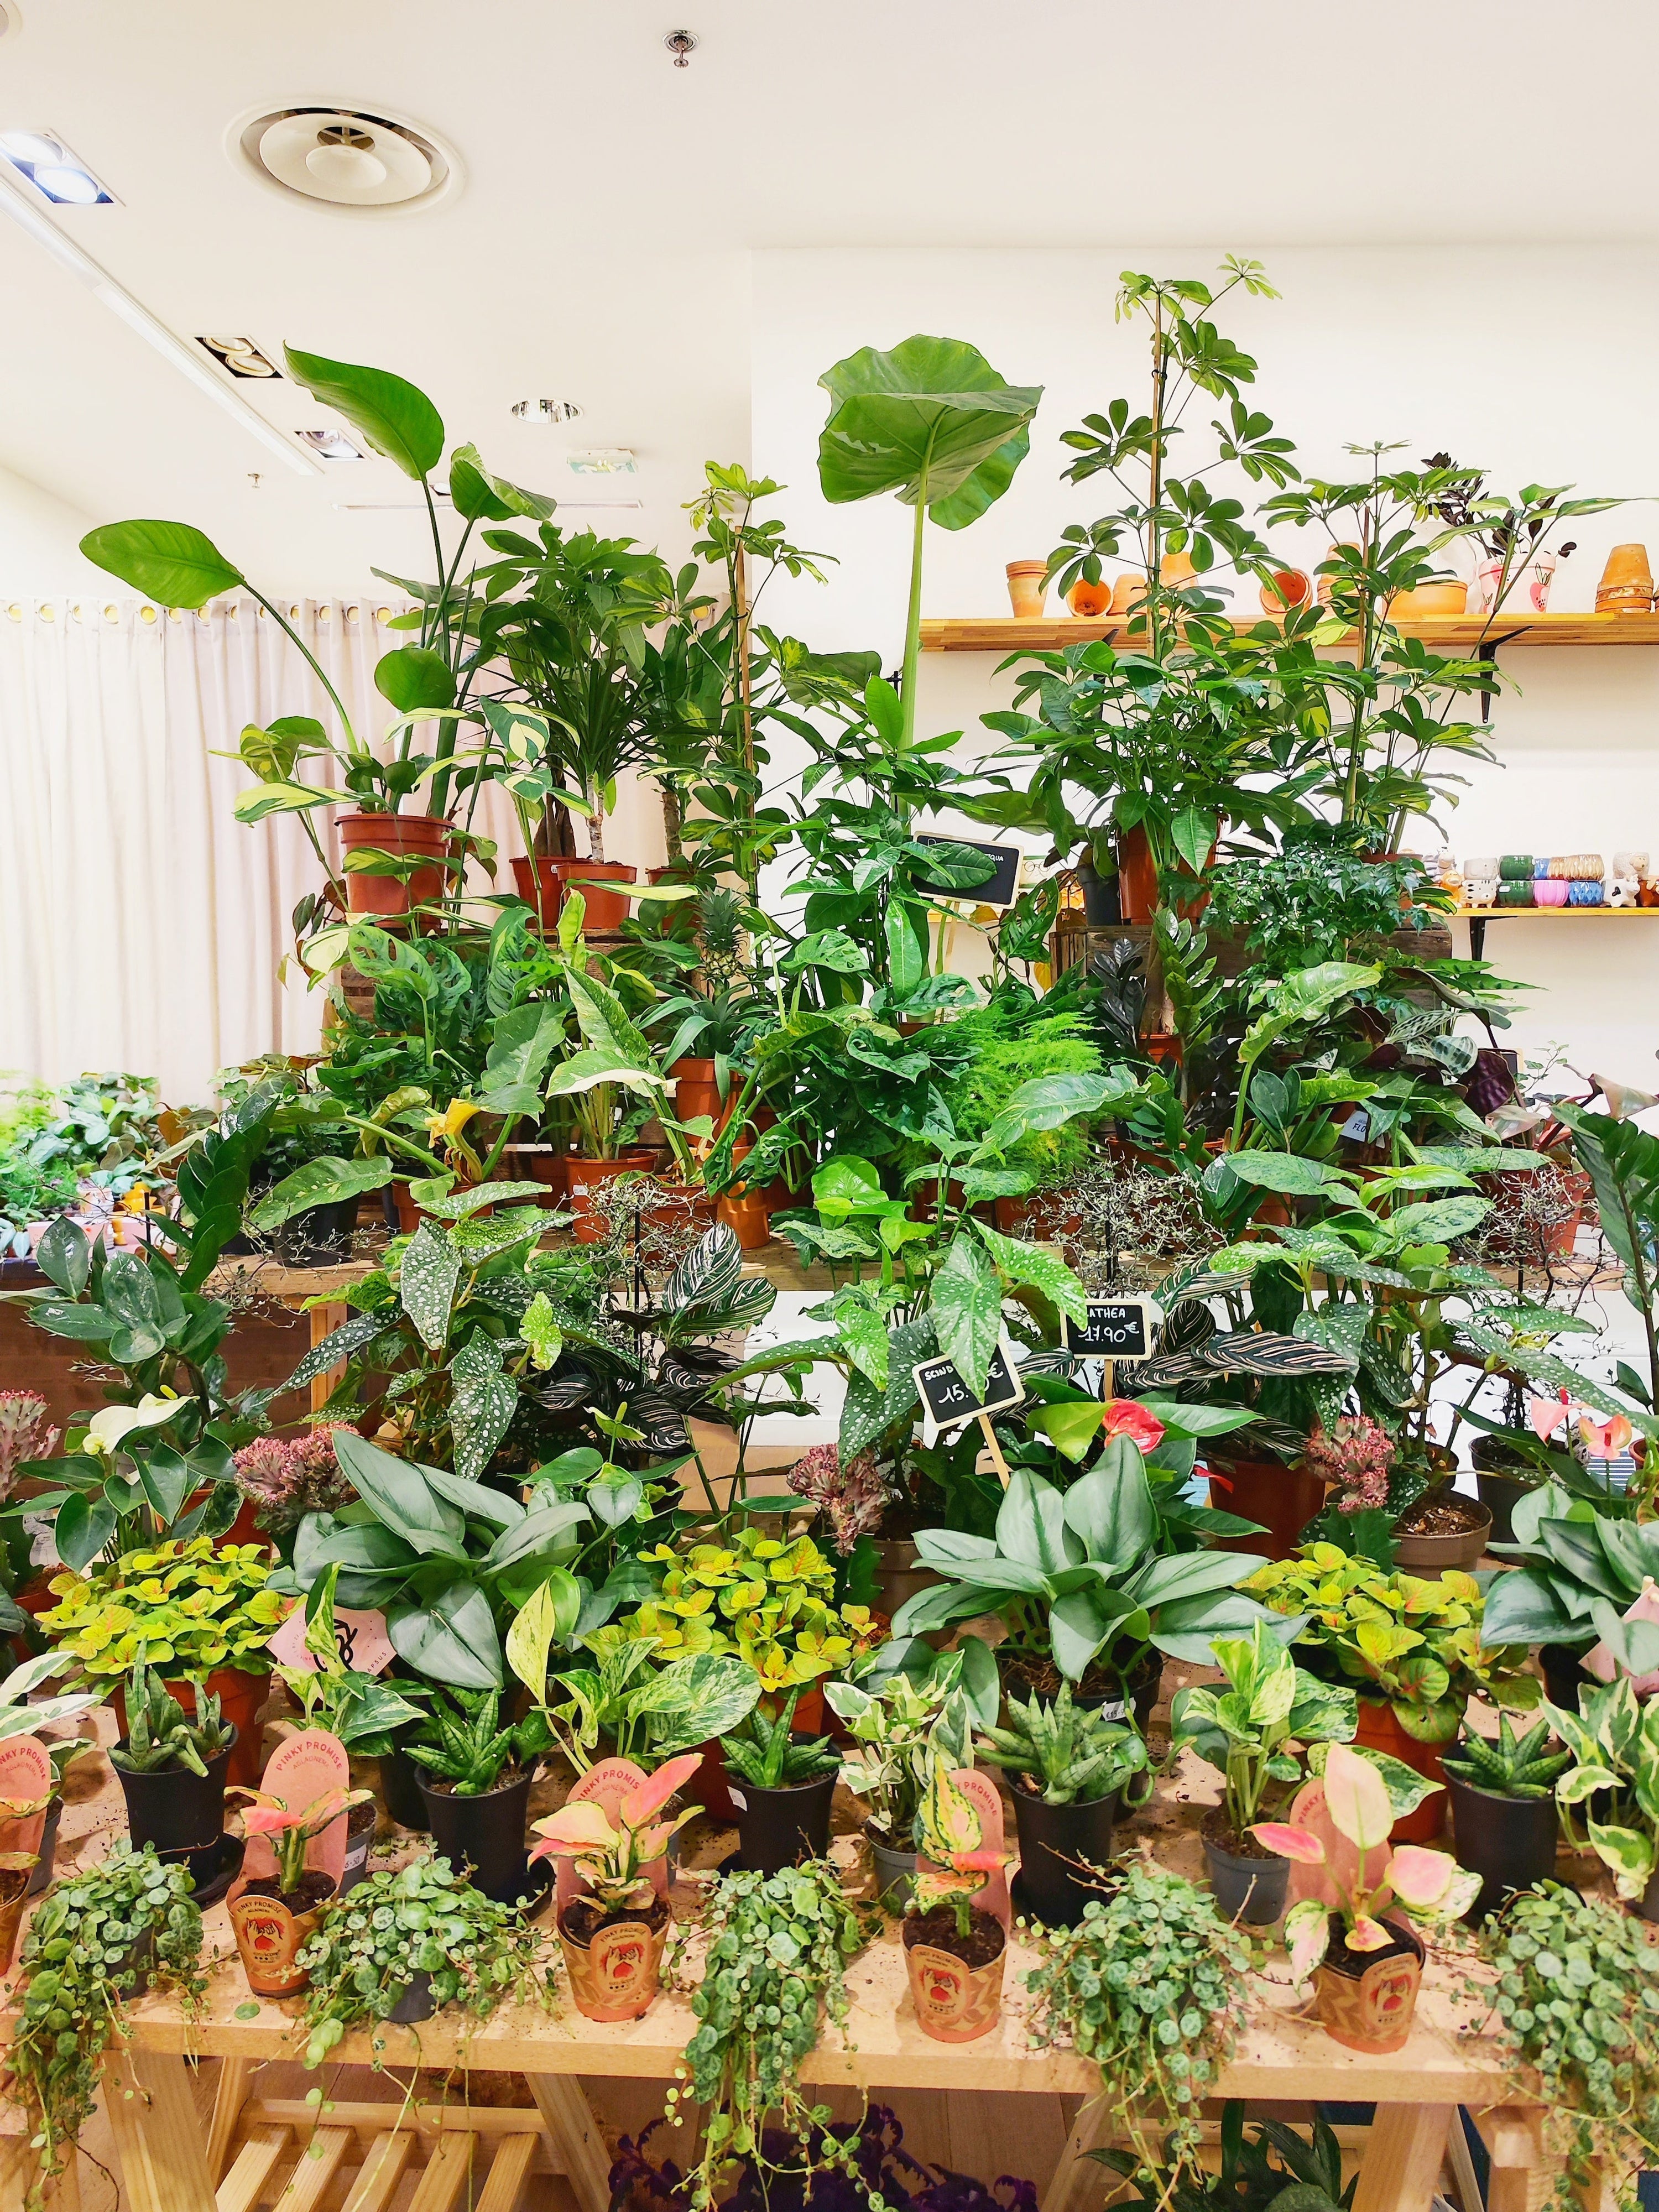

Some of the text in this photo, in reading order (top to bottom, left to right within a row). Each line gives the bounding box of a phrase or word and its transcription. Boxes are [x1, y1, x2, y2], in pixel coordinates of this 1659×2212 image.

[1087, 1307, 1125, 1319] ATHEA
[0, 1747, 46, 1780] NKY PROMISE
[275, 1741, 342, 1771] PINKY PROMISE
[293, 1756, 329, 1770] AGLAONEMA
[603, 1770, 640, 1790] PROMIS
[964, 1781, 997, 1816] PROMISE
[1298, 1794, 1318, 1824] PINKY
[237, 1901, 282, 1913] PINKY PROMISE
